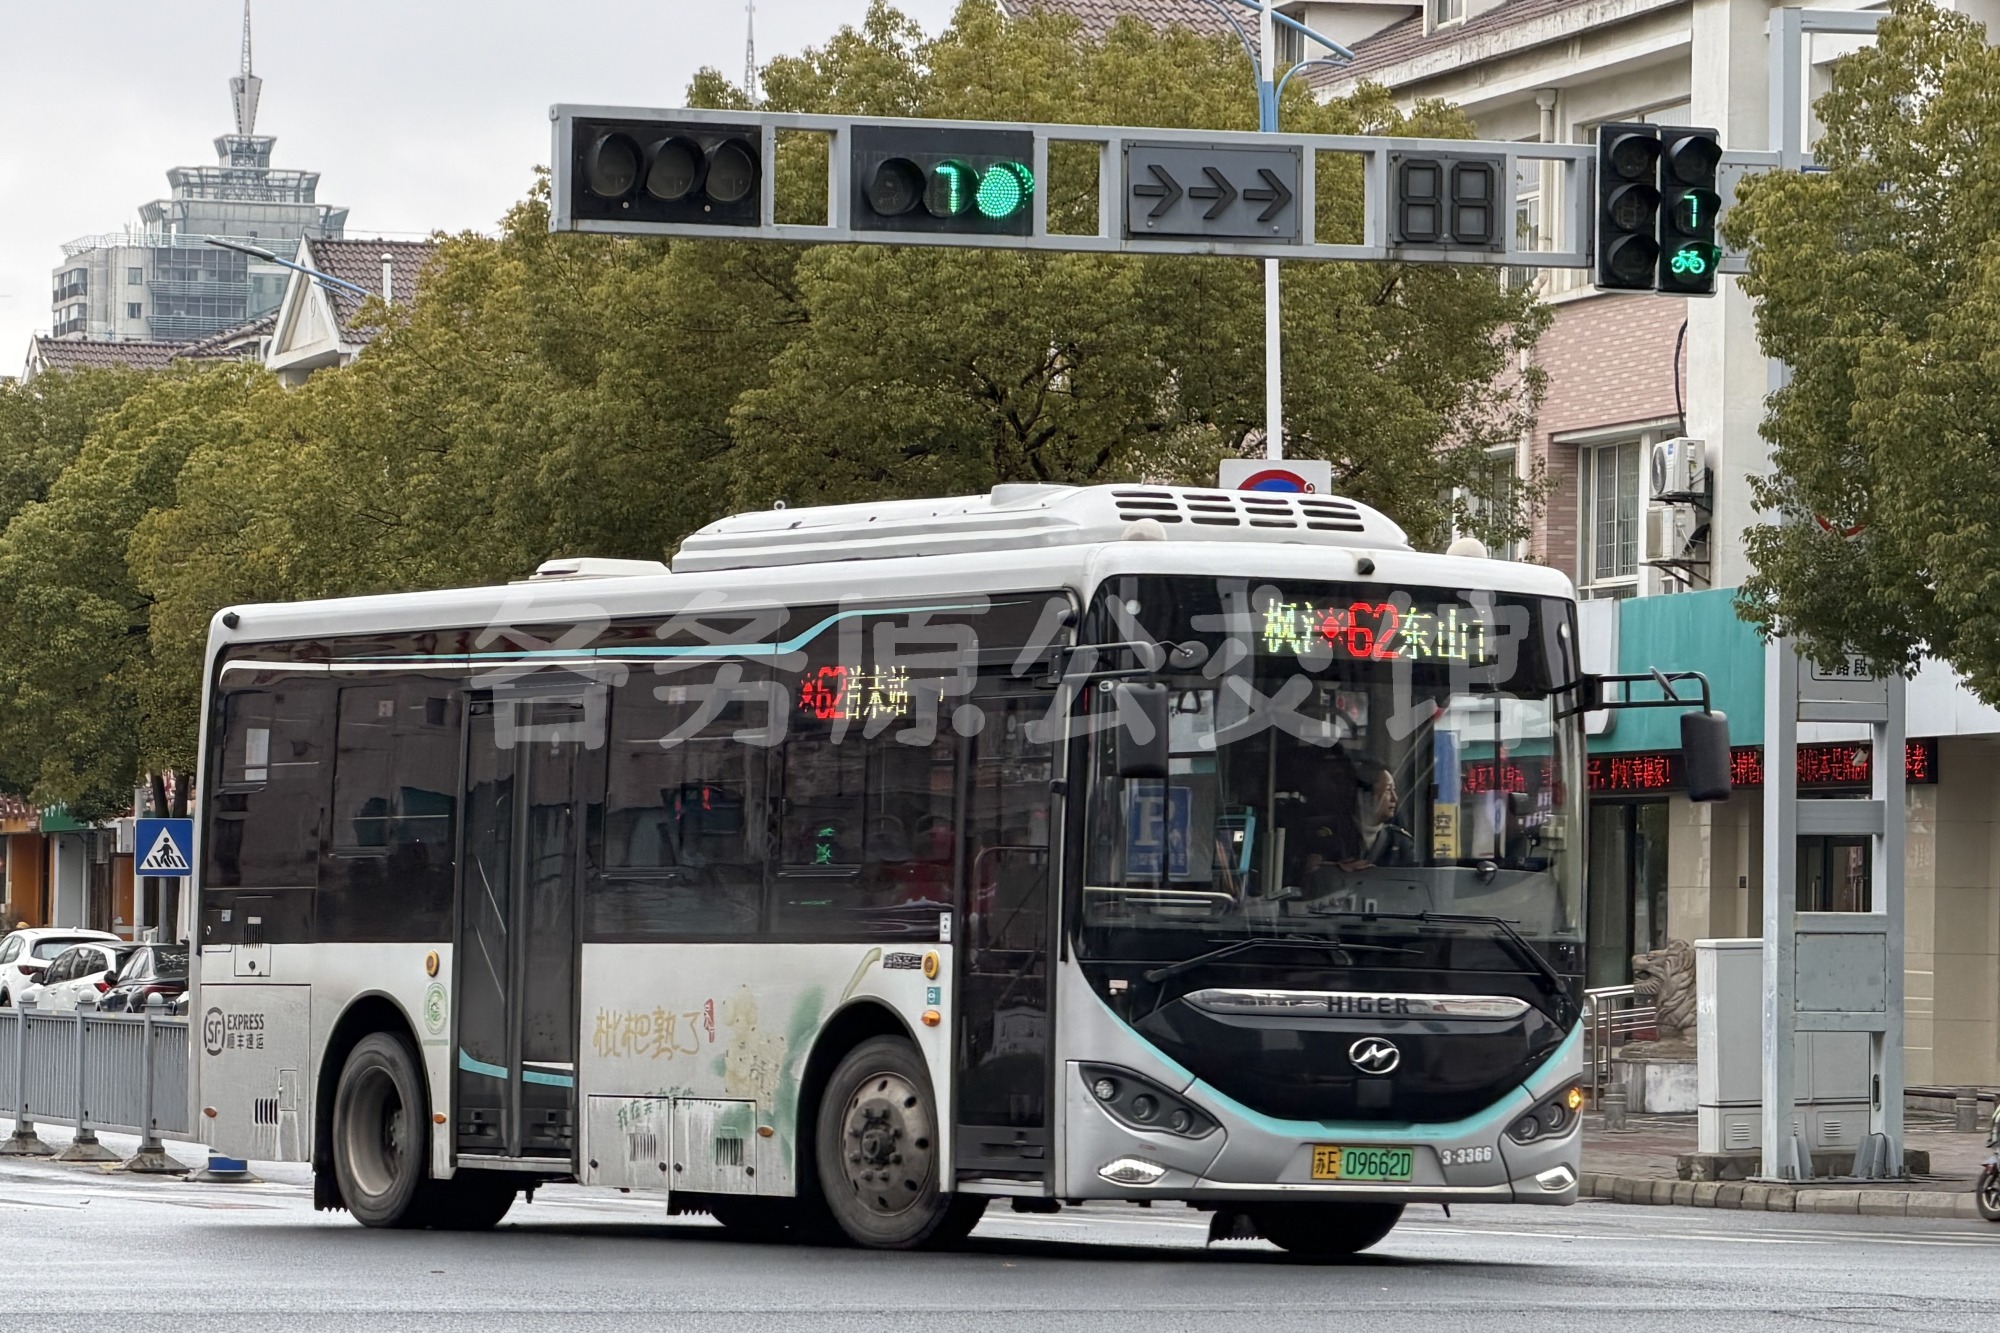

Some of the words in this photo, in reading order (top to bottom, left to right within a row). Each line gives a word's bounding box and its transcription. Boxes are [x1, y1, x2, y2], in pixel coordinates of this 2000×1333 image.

[935, 166, 957, 213] 7
[1348, 602, 1399, 658] 62
[1819, 658, 1868, 676] 路段
[1327, 996, 1409, 1014] HIGER
[227, 1014, 264, 1030] EXPRESS
[593, 1005, 701, 1061] 枇杷熟了
[1315, 1150, 1338, 1174] 苏E
[1346, 1151, 1411, 1176] 09662D
